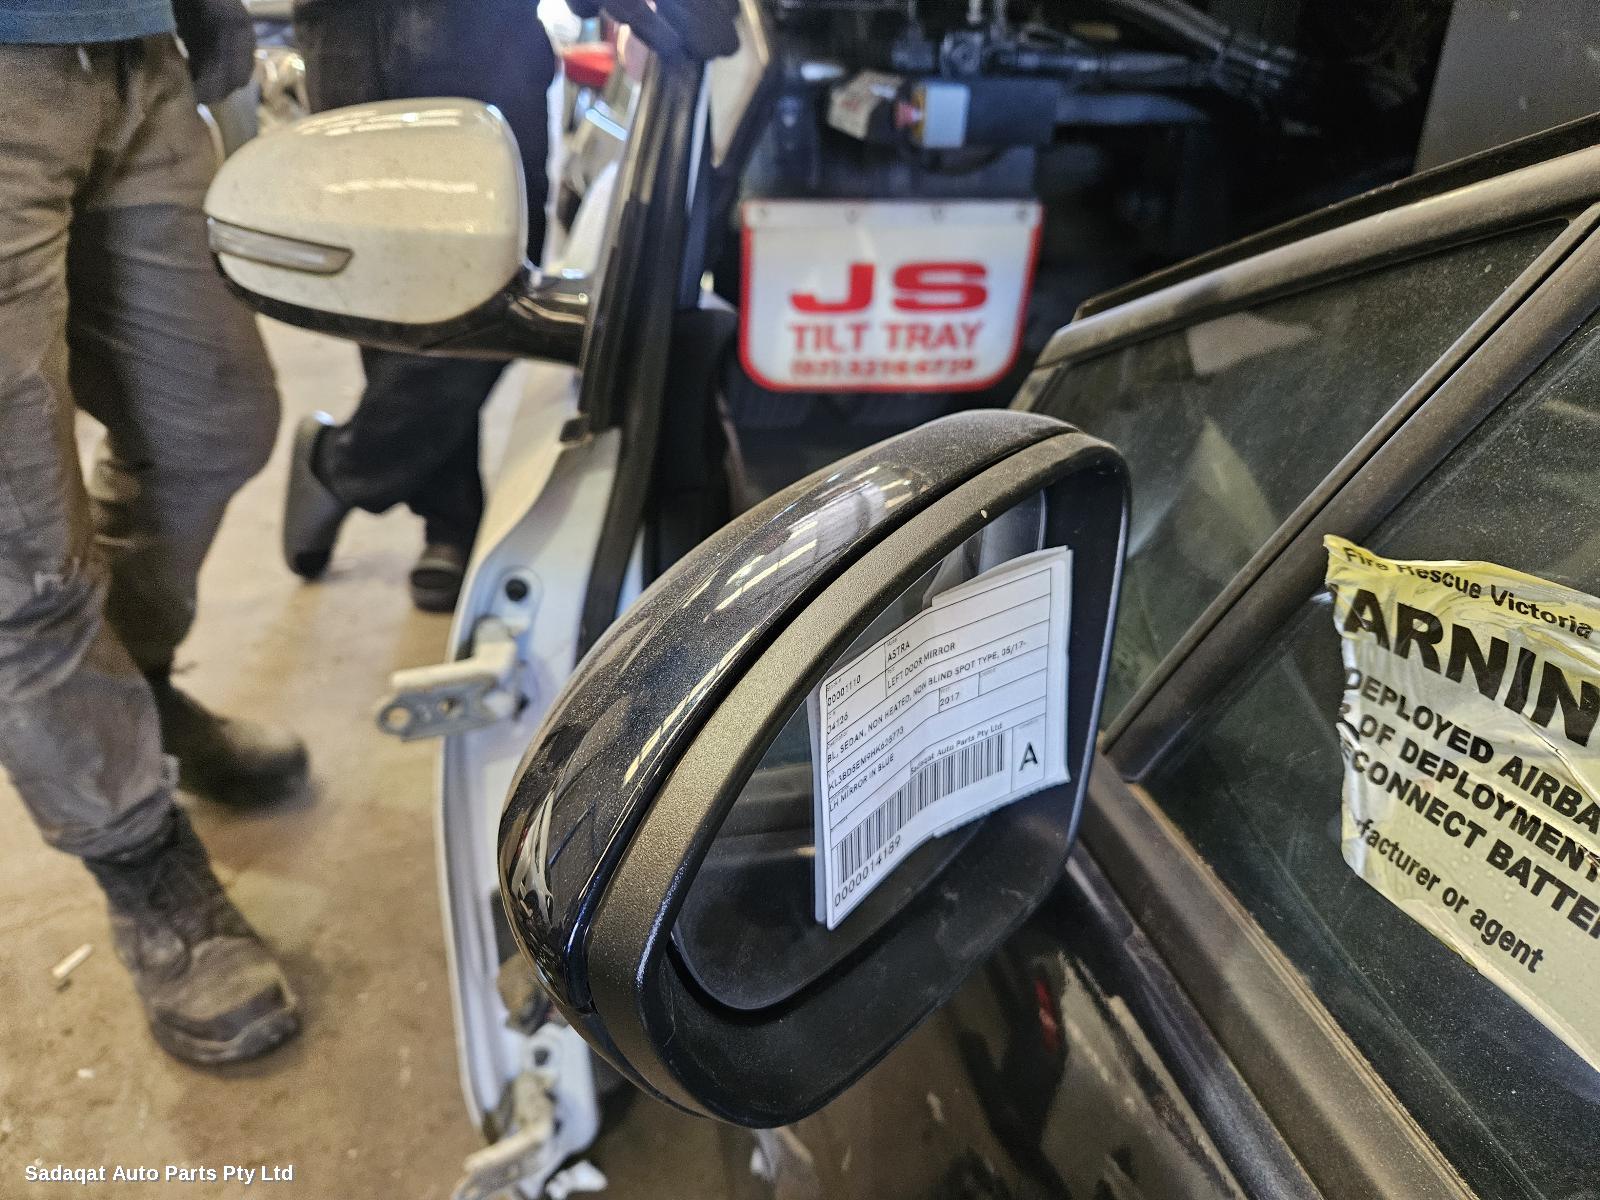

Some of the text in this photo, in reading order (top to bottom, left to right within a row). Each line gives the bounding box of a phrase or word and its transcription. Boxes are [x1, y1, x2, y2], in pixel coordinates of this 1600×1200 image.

[789, 261, 989, 314] JS
[789, 320, 984, 350] TILT TRAY
[1343, 547, 1594, 640] Fire Rescue Victoria
[887, 641, 911, 662] ASTRA
[887, 642, 956, 689] LEFT DOOR MIRROR
[1328, 583, 1600, 748] ARNIN
[867, 715, 883, 732] NON
[928, 670, 953, 686] BLIND
[955, 660, 976, 675] SPOT
[940, 691, 960, 707] 2017
[1345, 668, 1494, 764] DEPLOYED
[1497, 755, 1600, 835] AIRBA
[1360, 714, 1396, 746] OF
[840, 775, 868, 803] MIRROR
[877, 753, 894, 772] BLUE
[1019, 741, 1039, 772] A
[1352, 750, 1487, 849] CONNECT
[1357, 818, 1544, 974] facturer or agent
